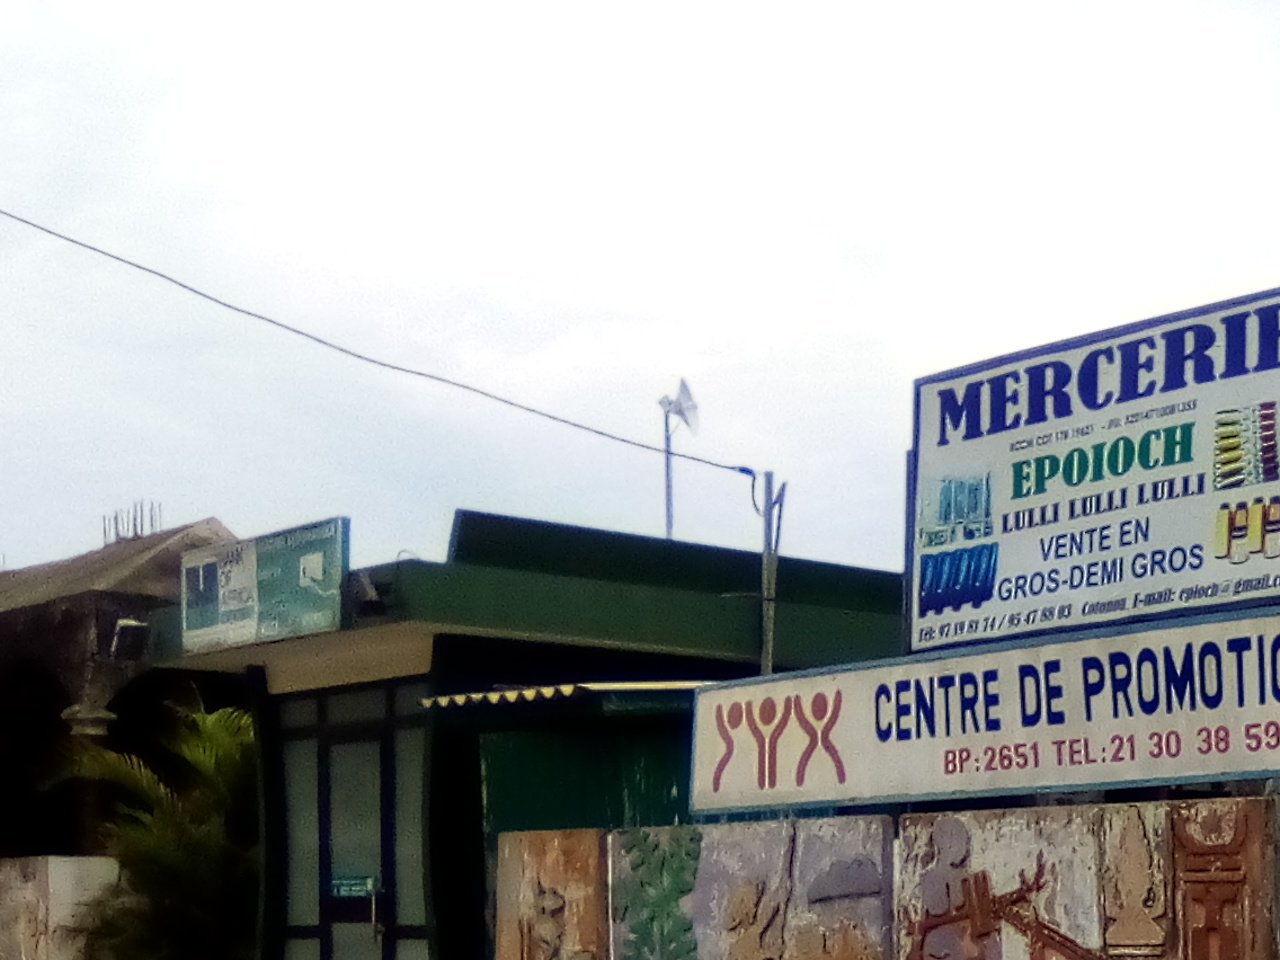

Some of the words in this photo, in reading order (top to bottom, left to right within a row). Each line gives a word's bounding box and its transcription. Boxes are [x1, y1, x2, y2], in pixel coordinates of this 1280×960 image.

[1010, 421, 1197, 500] EPOIOCH
[1001, 502, 1060, 534] LULLI
[1068, 487, 1128, 521] LULLI
[1136, 472, 1206, 506] LULLI
[1040, 525, 1112, 562] VENTE
[1119, 516, 1150, 547] EN
[998, 557, 1123, 601] GROS-DEMI
[1131, 543, 1205, 579] GROS
[874, 665, 1002, 743] CENTRE
[1018, 658, 1066, 728] DE
[943, 741, 1042, 776] BP:2651
[1149, 728, 1182, 760] 30
[1197, 724, 1231, 754] 38
